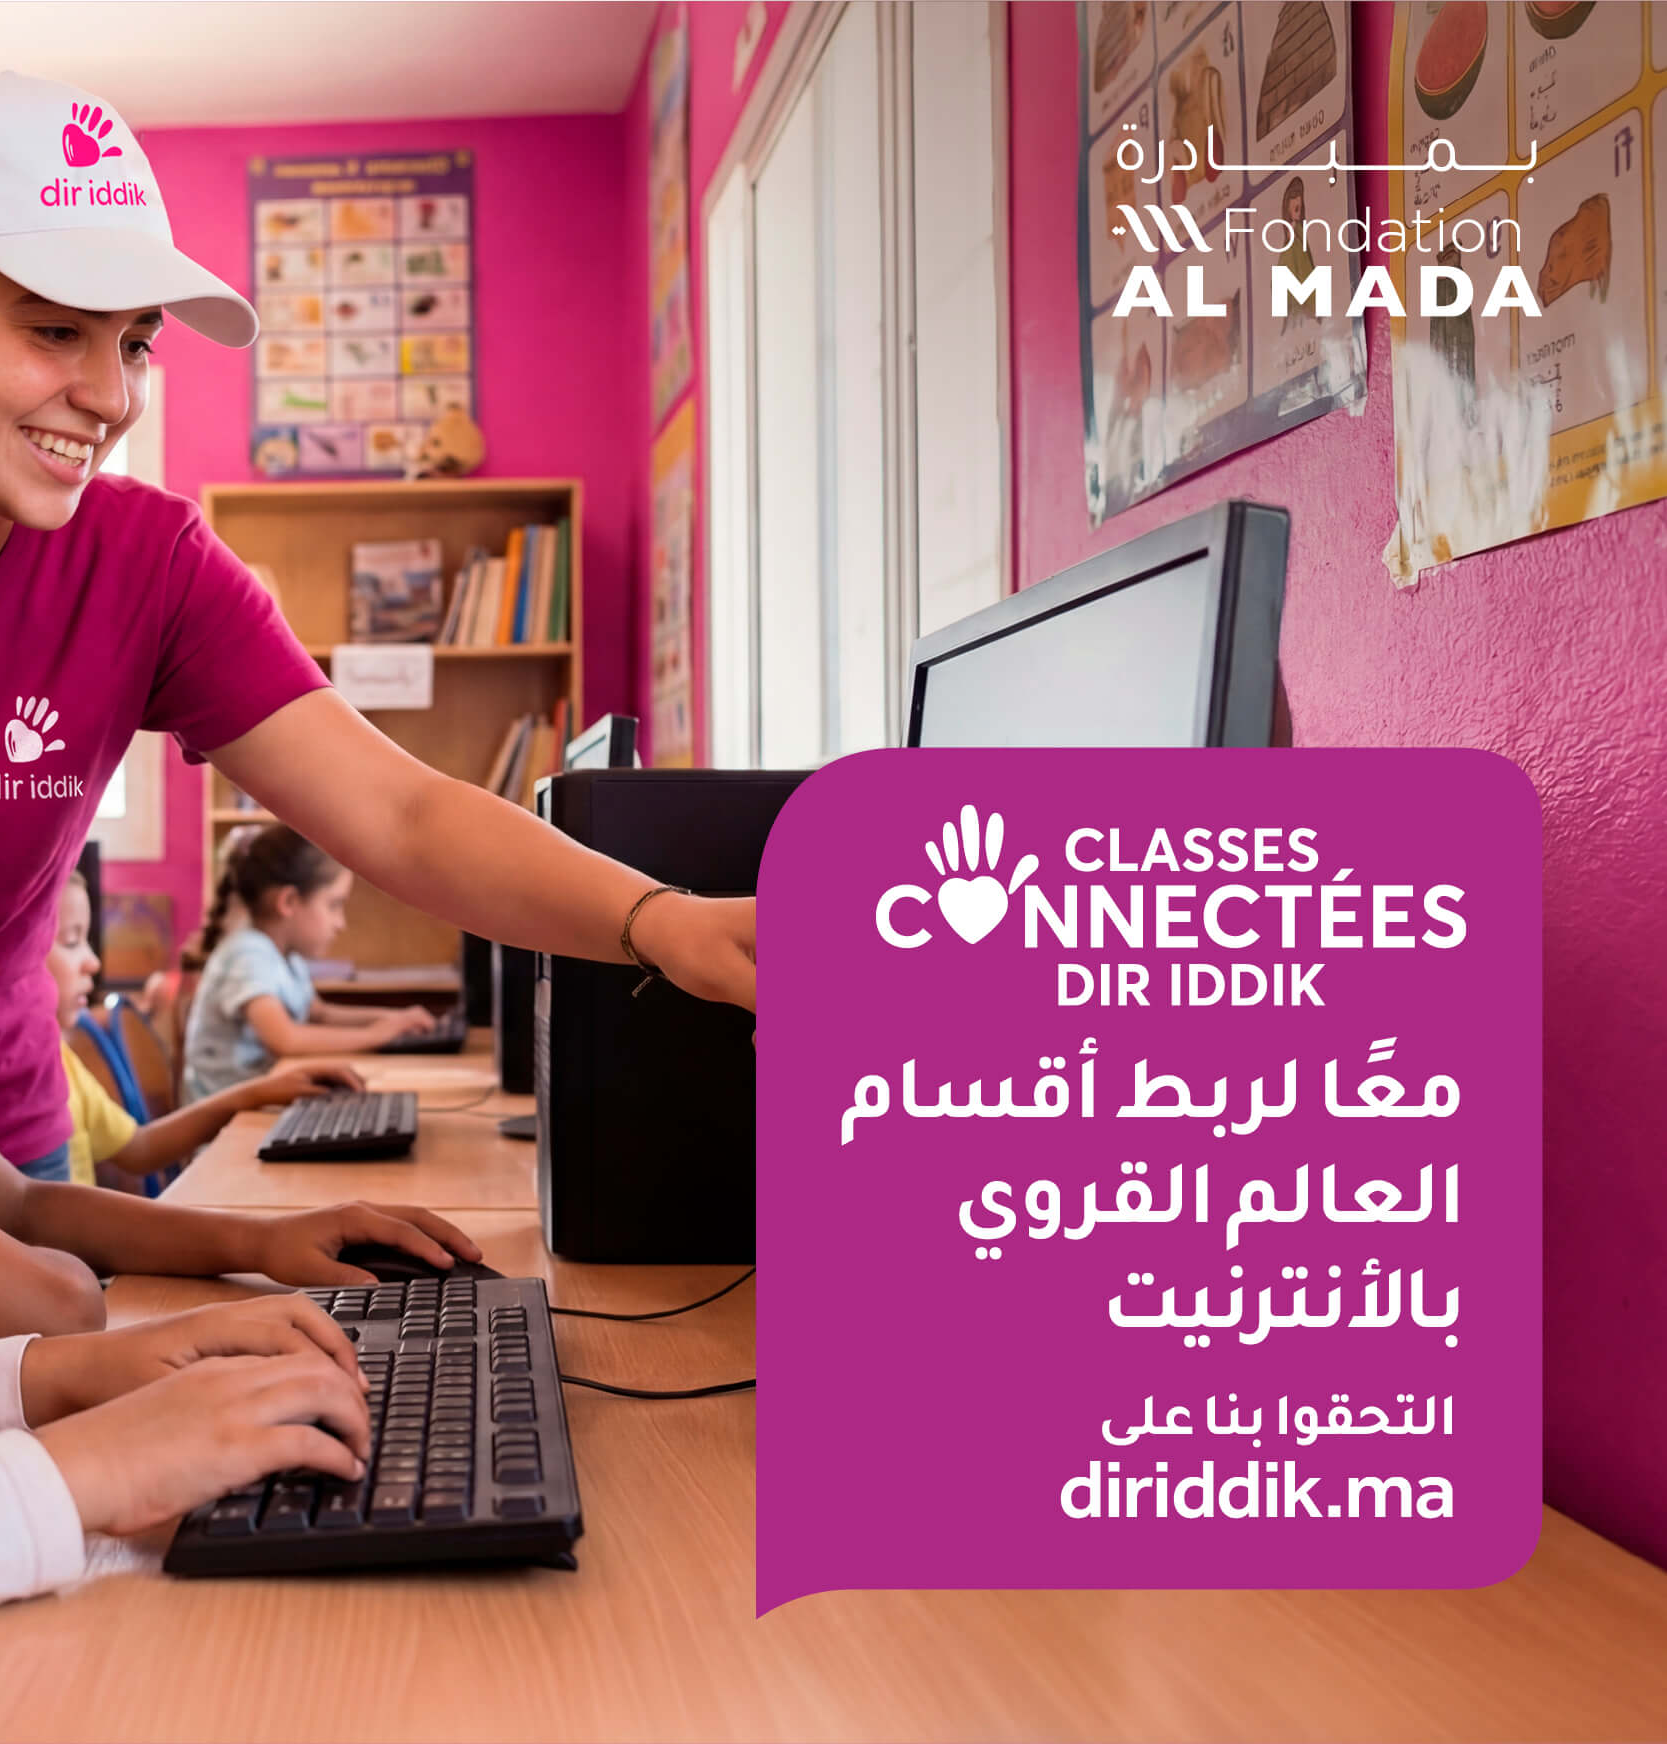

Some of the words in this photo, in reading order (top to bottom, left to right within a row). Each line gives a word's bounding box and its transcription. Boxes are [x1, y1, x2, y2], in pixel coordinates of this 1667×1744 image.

[40, 178, 82, 207] dir
[89, 179, 147, 206] iddik
[30, 774, 84, 800] iddik
